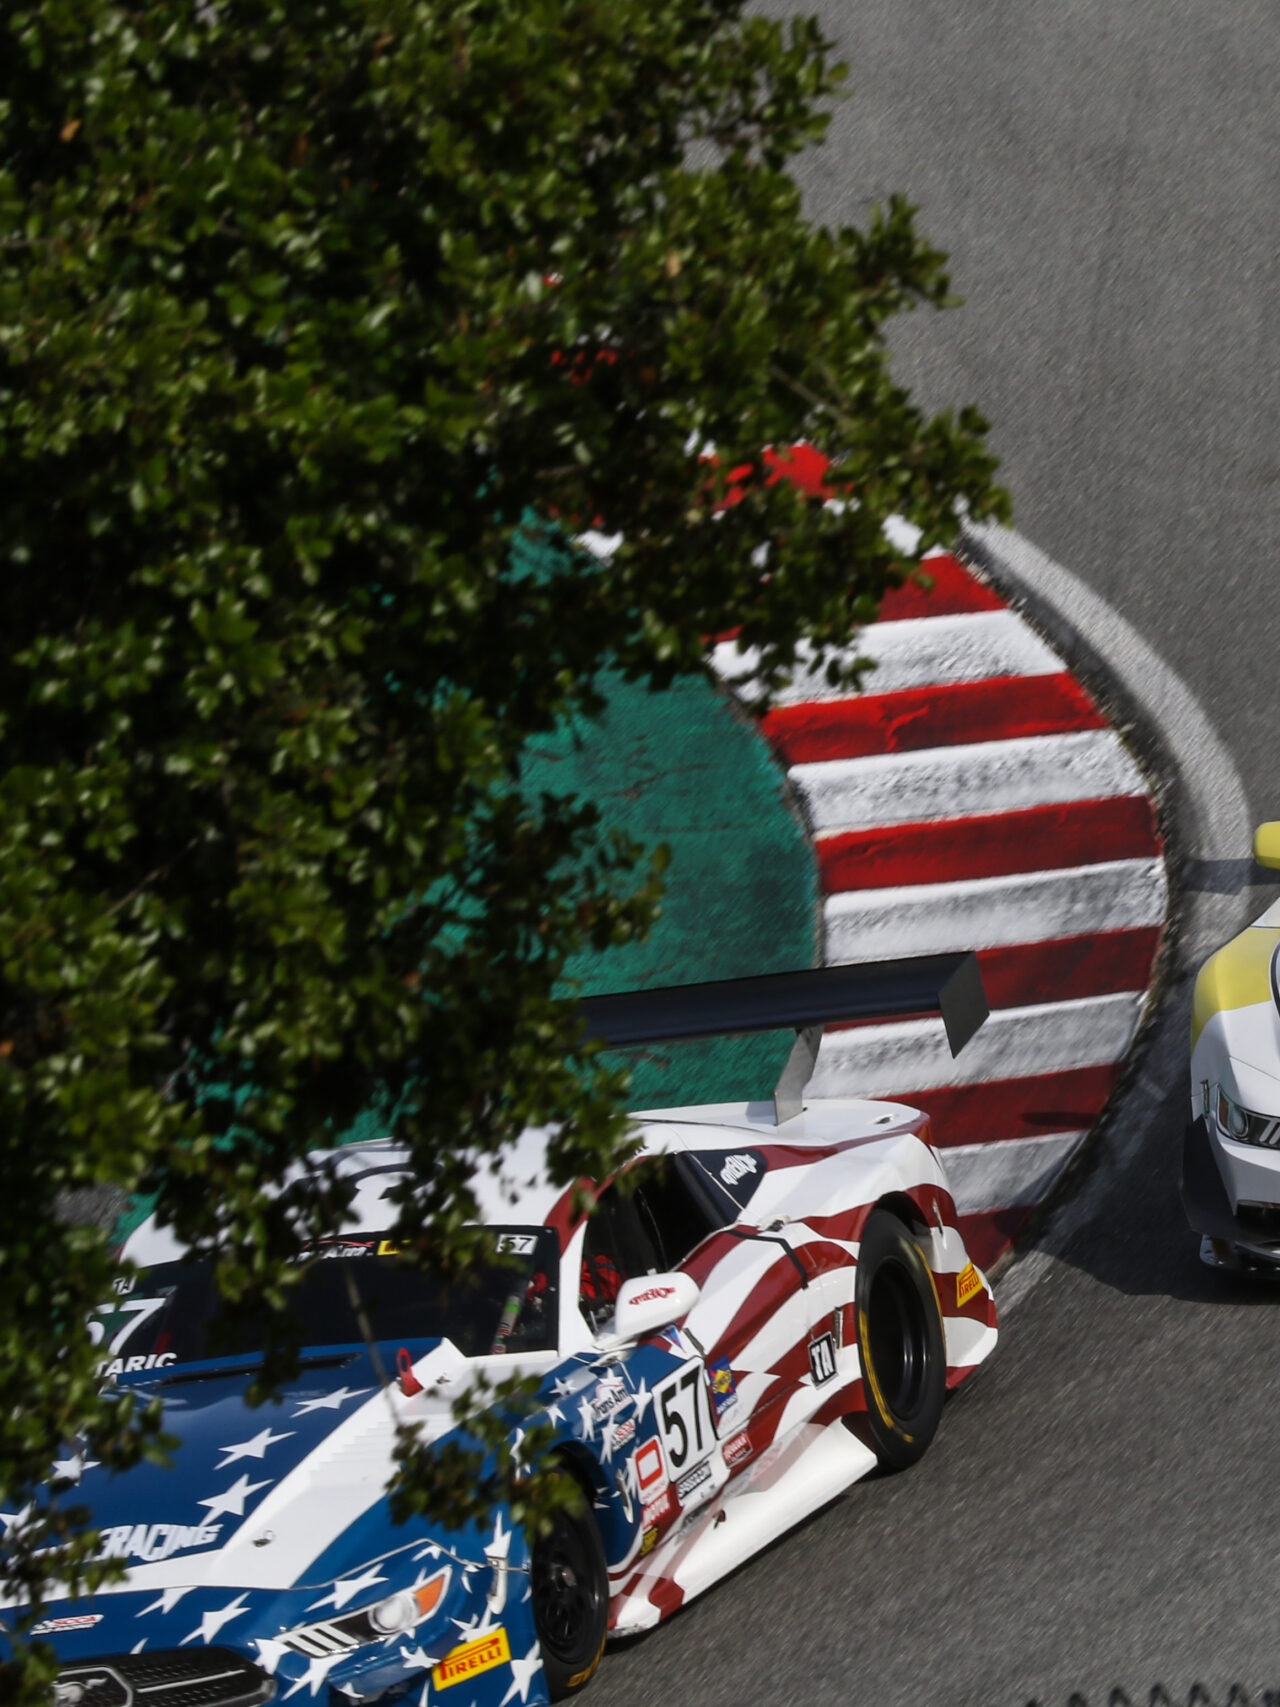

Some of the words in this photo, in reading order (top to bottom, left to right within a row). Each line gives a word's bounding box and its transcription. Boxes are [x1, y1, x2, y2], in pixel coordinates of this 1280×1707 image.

[958, 1267, 979, 1299] PIRELLI
[810, 1338, 835, 1383] TA
[660, 1364, 704, 1468] 57
[437, 1637, 502, 1681] PIRELLI
